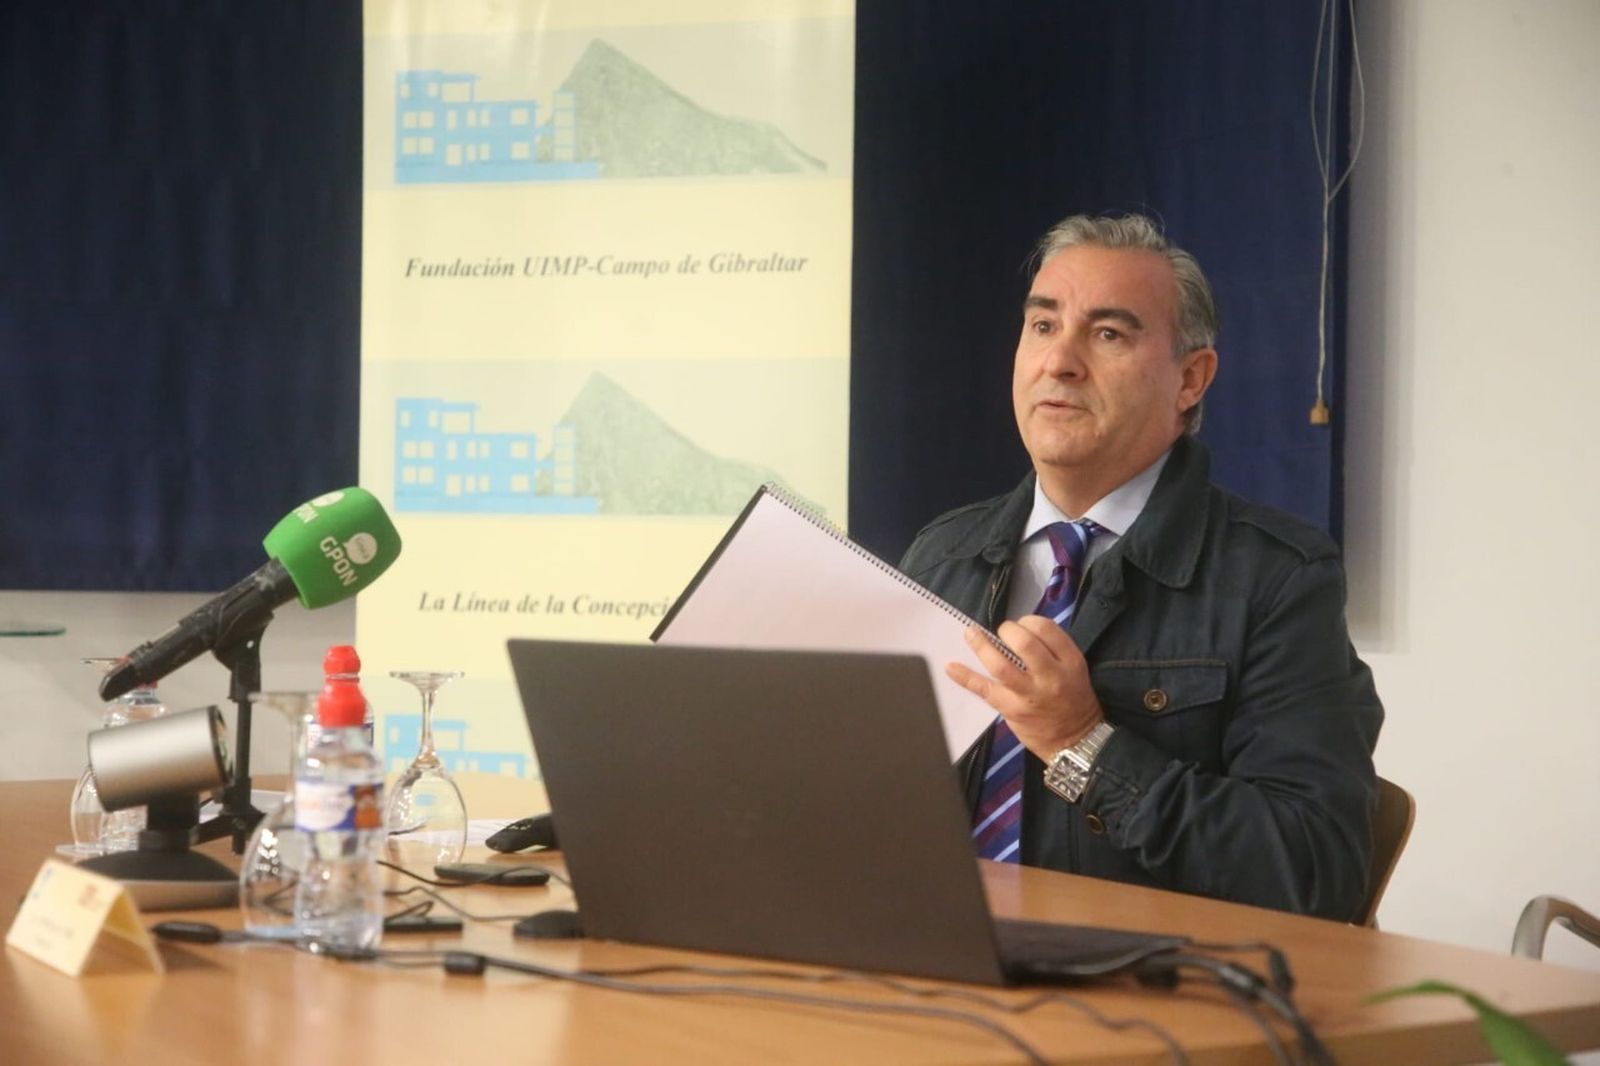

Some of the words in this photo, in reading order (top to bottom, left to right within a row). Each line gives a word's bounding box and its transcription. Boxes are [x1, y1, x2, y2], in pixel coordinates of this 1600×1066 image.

[404, 255, 516, 279] Fundación
[522, 254, 671, 280] UIMP-Campo
[676, 253, 702, 275] de
[708, 252, 809, 275] Gibraltar
[418, 591, 446, 612] La
[451, 591, 511, 614] Línea
[515, 594, 541, 615] de
[545, 595, 565, 615] la
[572, 595, 671, 621] Concepci
